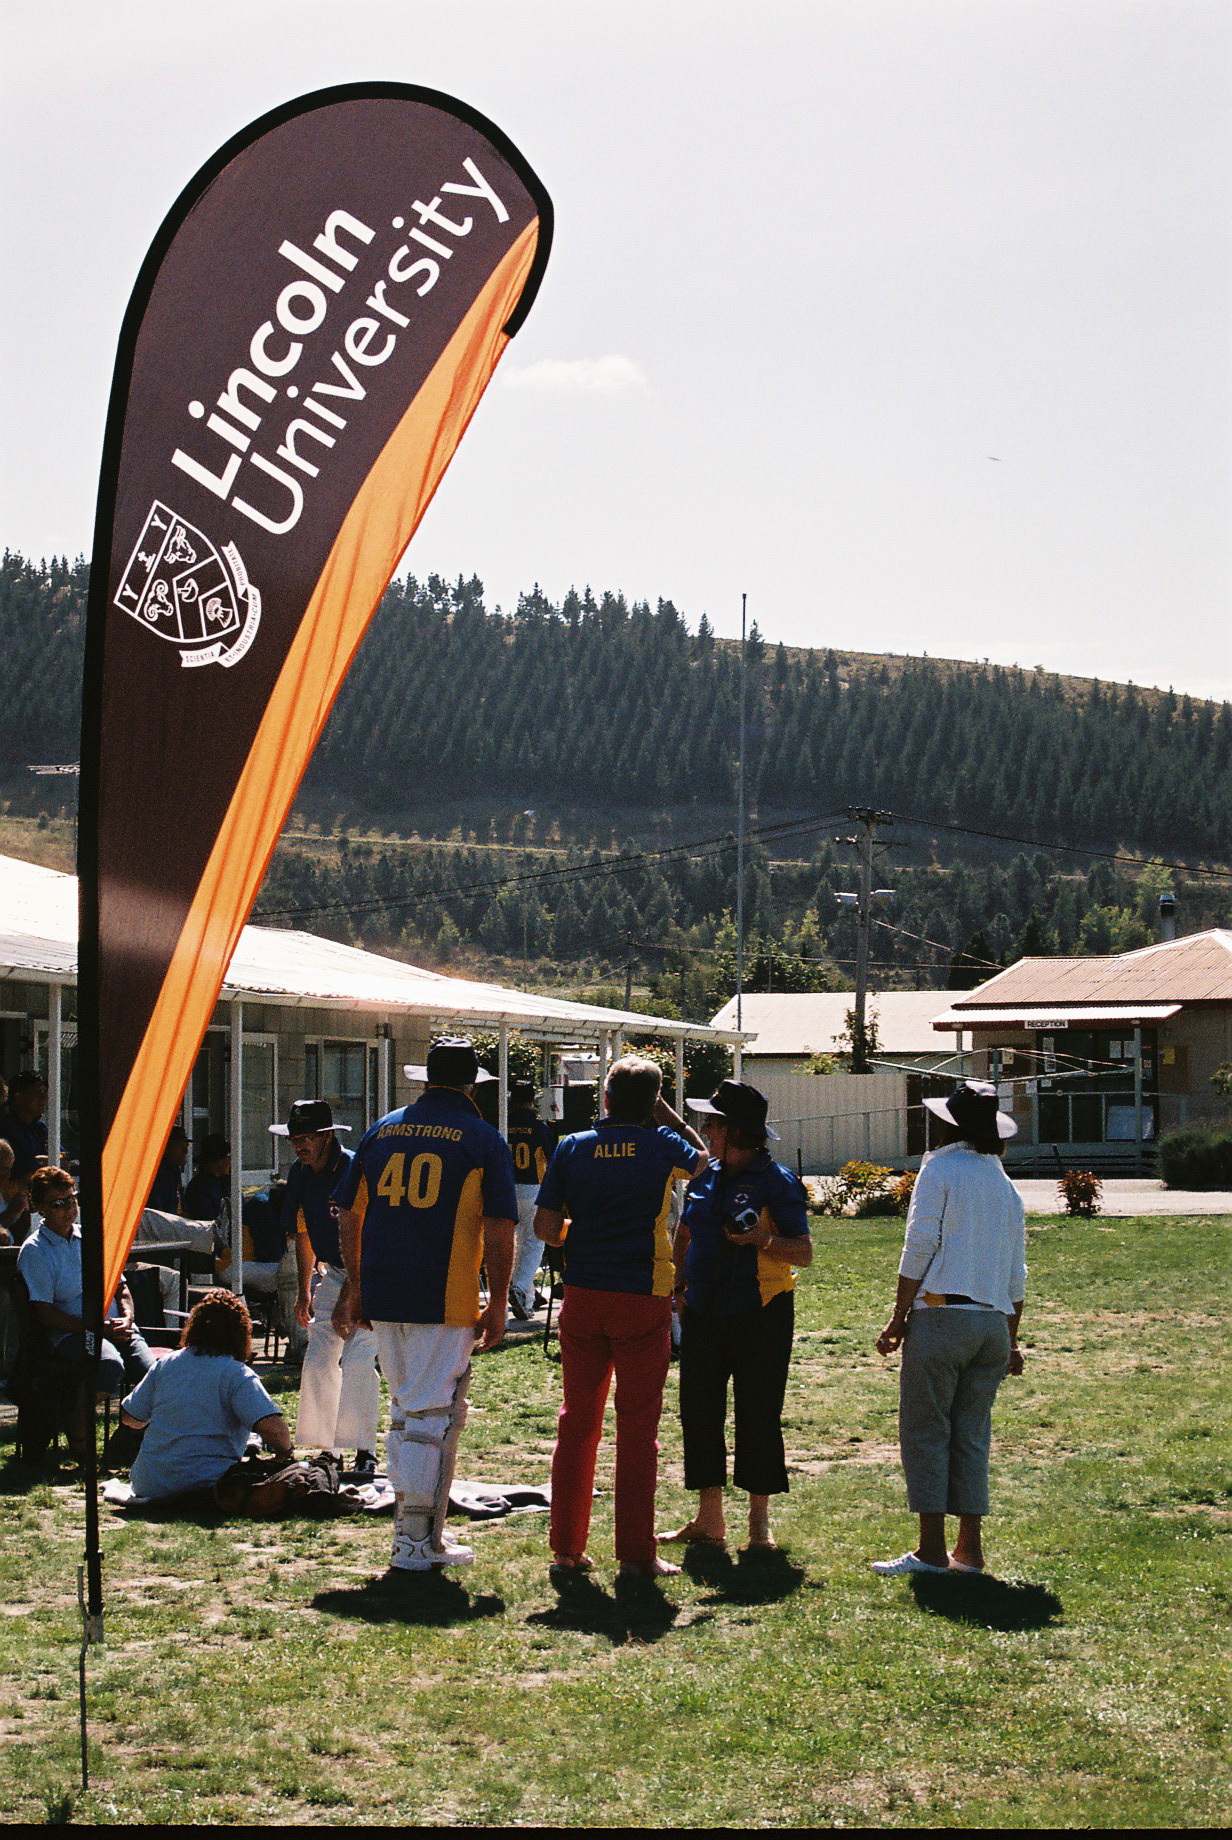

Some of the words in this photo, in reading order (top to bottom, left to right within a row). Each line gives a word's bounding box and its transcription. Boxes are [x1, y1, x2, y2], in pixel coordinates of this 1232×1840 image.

[170, 208, 377, 501] Lincoln
[231, 156, 510, 535] University
[185, 651, 215, 663] SCIENTIA
[1027, 1020, 1066, 1028] RECEPTION
[377, 1123, 463, 1142] ARMSTRONG
[594, 1142, 636, 1159] ALLIE
[377, 1152, 443, 1209] 40
